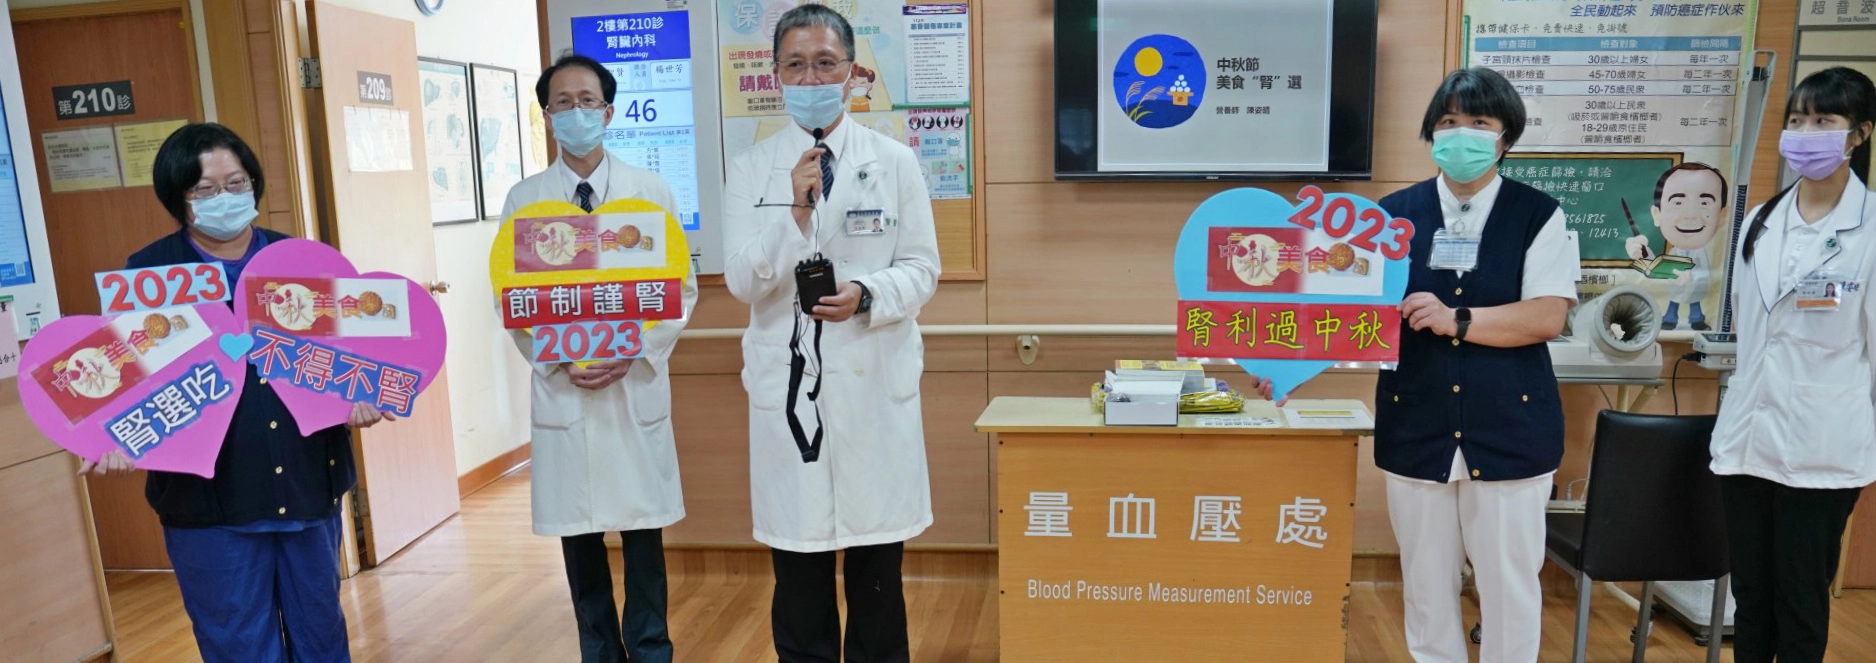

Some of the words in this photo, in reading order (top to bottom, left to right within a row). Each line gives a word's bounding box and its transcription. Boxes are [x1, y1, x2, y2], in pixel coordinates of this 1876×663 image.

[1570, 4, 1637, 17] 全民動起來
[1650, 3, 1745, 17] 預防癌症作伙來
[1811, 0, 1875, 14] 超音波
[596, 16, 664, 33] 2樓第210診
[606, 33, 656, 49] 腎臟內科
[1498, 39, 1536, 49] 檢查項目
[1601, 39, 1638, 48] 檢查對象
[615, 51, 648, 59] Nephrology
[728, 49, 774, 61] 出現發燒或
[1216, 57, 1260, 72] 中秋節
[1588, 55, 1648, 64] 30歲以上婦女
[1689, 54, 1729, 63] 每年一次
[1588, 69, 1646, 79] 45-70歲婦女
[1683, 67, 1733, 79] 每二年一次
[360, 76, 392, 101] 第209診
[1588, 84, 1645, 94] 50-75歲民眾
[1682, 84, 1731, 94] 每二年一次
[58, 87, 131, 116] 第210診
[625, 98, 657, 123] 46
[1585, 100, 1646, 110] 30歲以上民眾
[1581, 123, 1647, 133] 18-29歲原住民
[1680, 117, 1728, 127] 每二年一次
[1287, 184, 1415, 260] 2023
[523, 226, 621, 259] 中秋美食
[1218, 238, 1331, 281] 中秋美食
[102, 264, 226, 313] 2023
[507, 281, 666, 319] 節制謹腎
[256, 287, 363, 324] 中秋美食
[535, 321, 643, 362] 2023
[1186, 307, 1391, 352] 腎利過中秋
[51, 327, 159, 398] 中秋美食
[250, 329, 419, 414] 不得不腎
[110, 364, 231, 456] 腎選吃
[1023, 491, 1328, 549] 量血壓處
[1027, 579, 1071, 600] Blood
[1076, 580, 1143, 602] Pressure
[1148, 582, 1251, 604] Measurement
[1256, 584, 1312, 606] Service
